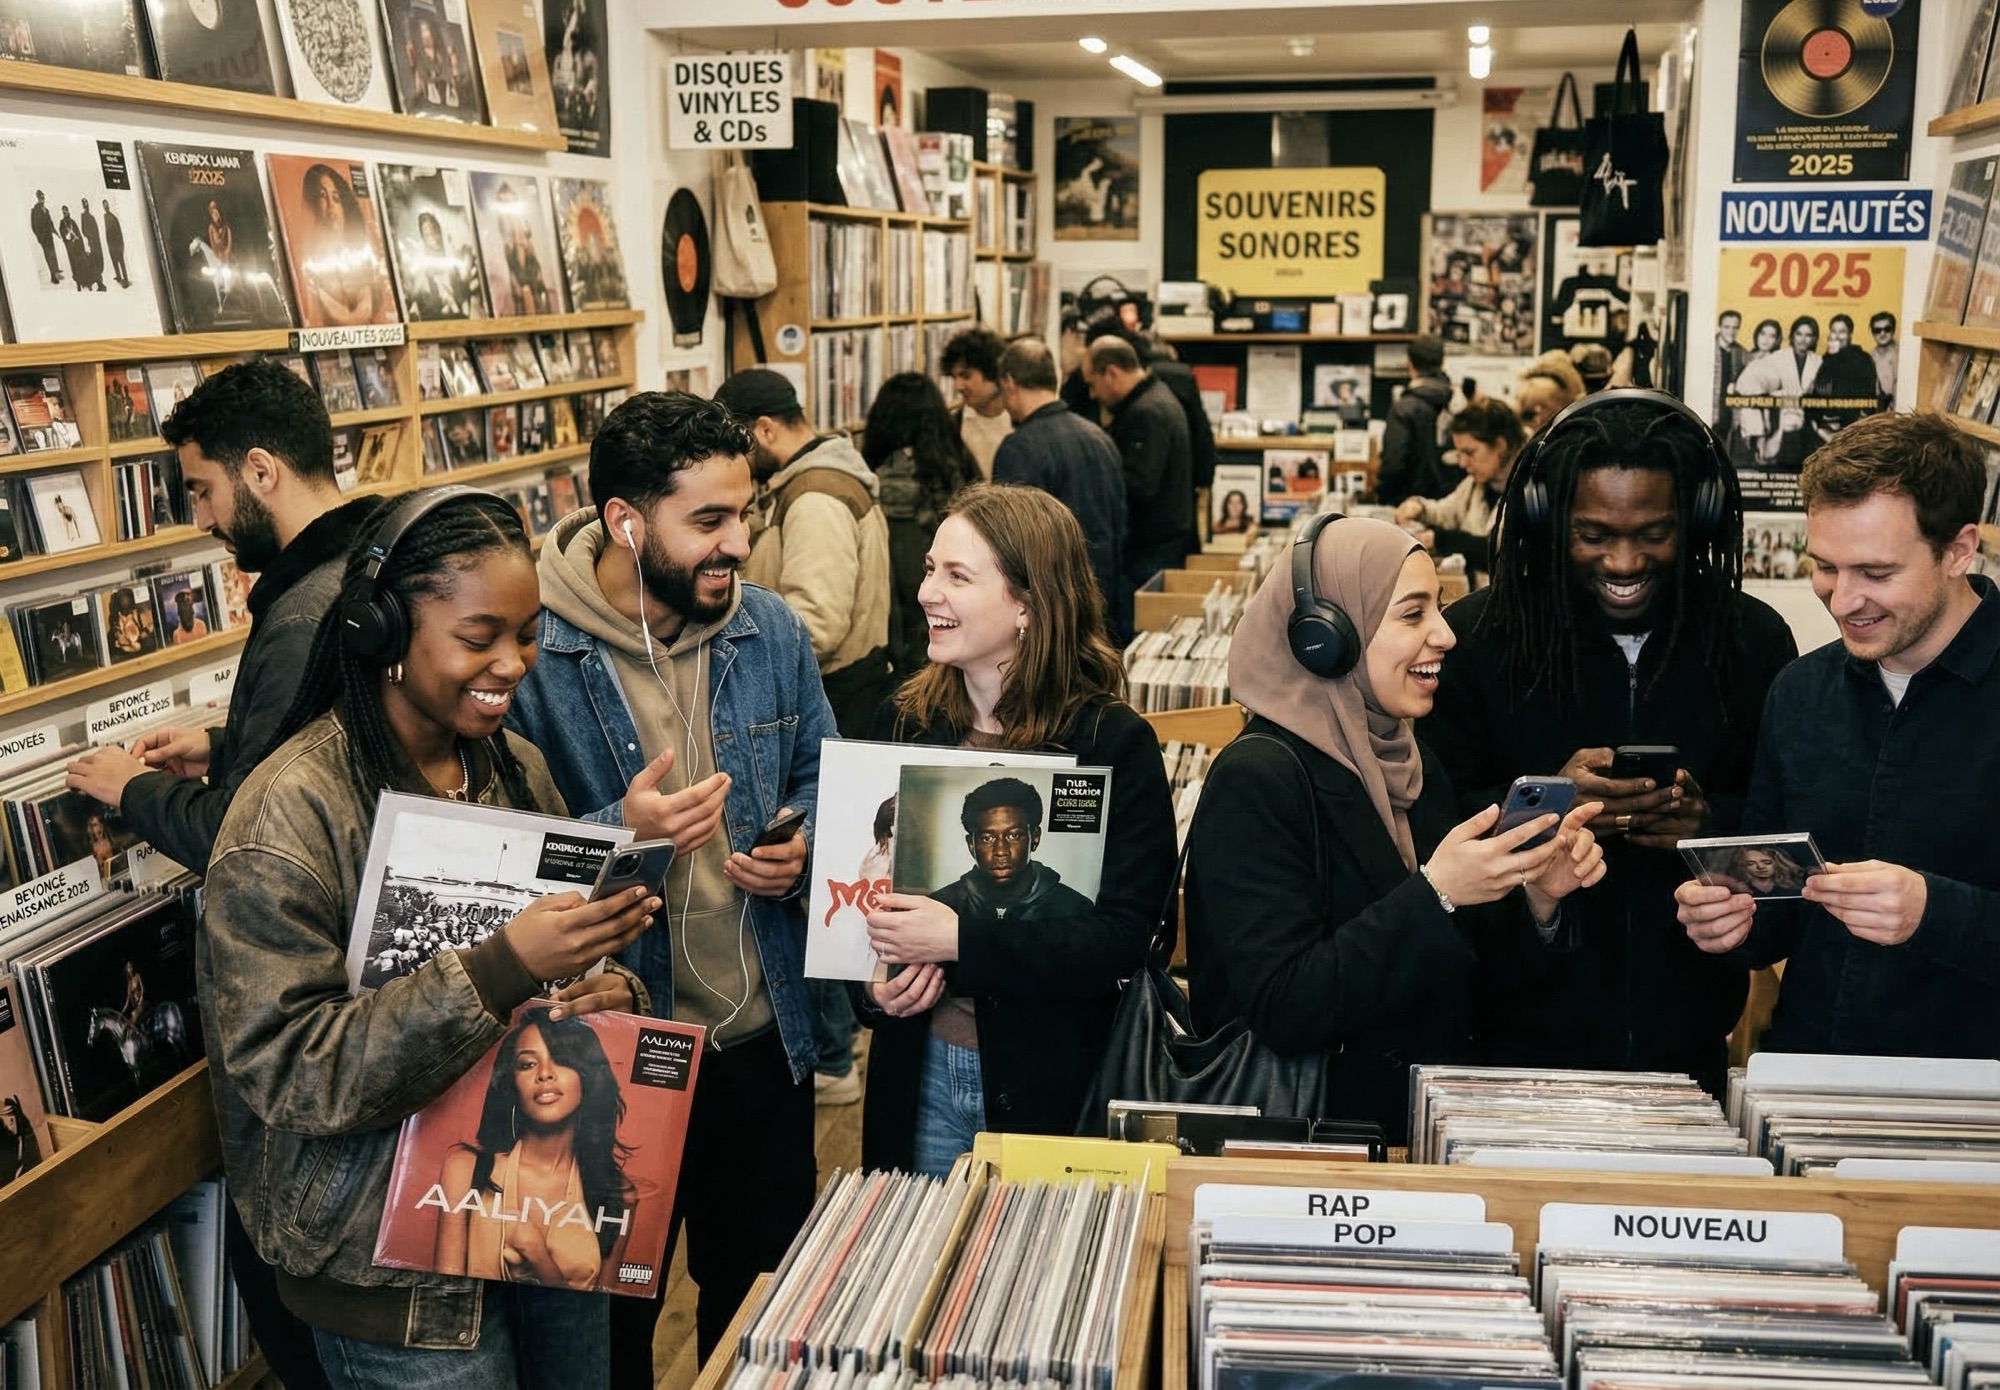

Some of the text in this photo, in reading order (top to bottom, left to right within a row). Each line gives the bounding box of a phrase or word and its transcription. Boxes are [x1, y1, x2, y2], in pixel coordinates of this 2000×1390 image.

[675, 60, 783, 88] DISQUES
[678, 90, 780, 114] VINYLES
[693, 120, 767, 143] & CDs
[1788, 154, 1854, 176] 2025
[1205, 189, 1376, 220] SOUVENIRS
[1725, 191, 1926, 235] NOUVEAUTÉS
[1219, 231, 1360, 259] SONORES
[1748, 252, 1872, 298] 2025
[15, 872, 67, 906] BEYONCÉ
[0, 879, 90, 931] ENAISSANCE 2025
[414, 1183, 631, 1236] AALIYAH
[1308, 1194, 1370, 1217] RAP
[1334, 1223, 1396, 1245] POP
[1614, 1214, 1767, 1243] NOUVEAU
